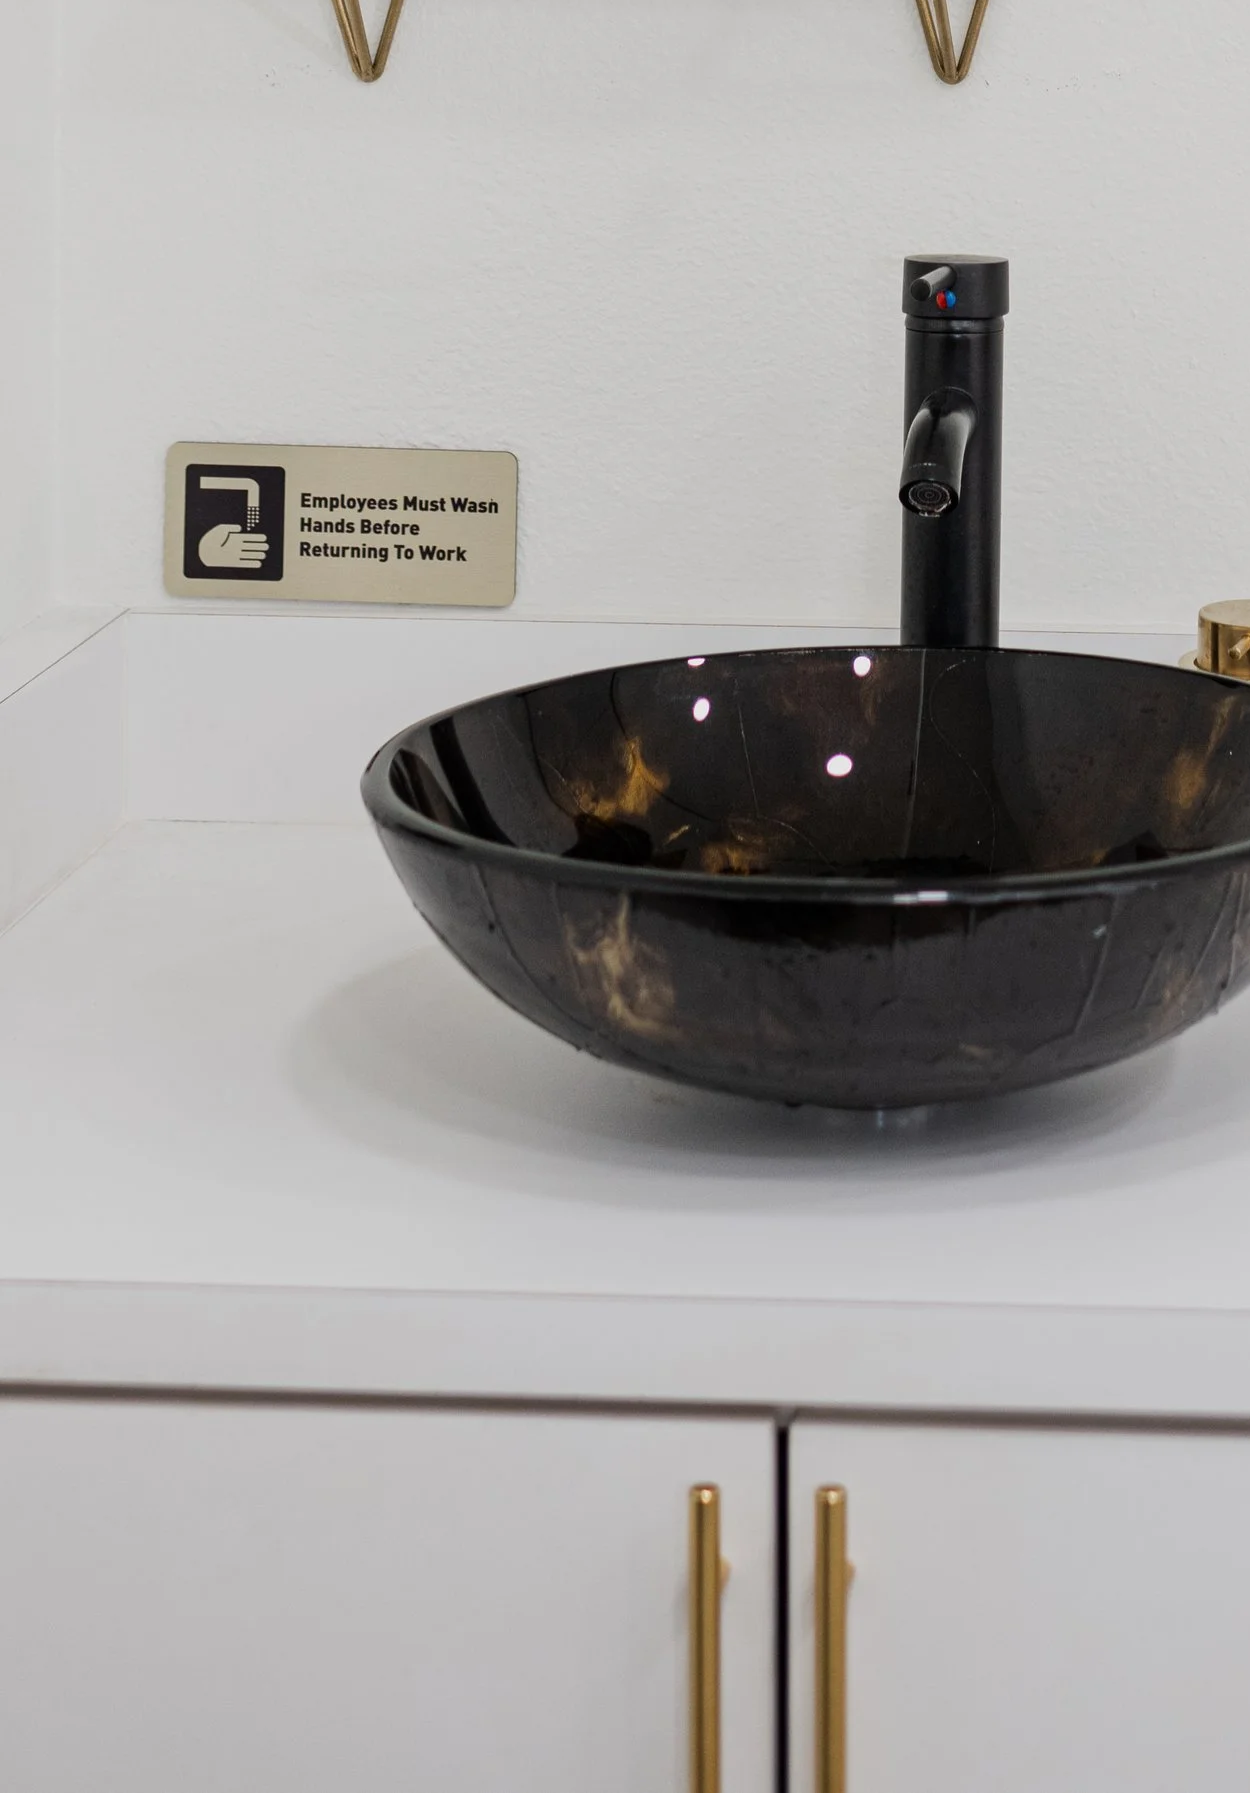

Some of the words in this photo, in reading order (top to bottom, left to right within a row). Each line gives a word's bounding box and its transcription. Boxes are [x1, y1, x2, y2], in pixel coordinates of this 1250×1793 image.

[300, 493, 398, 512] Employees
[403, 496, 446, 512] Must
[300, 517, 355, 533] Hands
[360, 519, 420, 535] Before
[300, 542, 389, 562] Returning
[394, 544, 414, 560] To
[420, 546, 467, 562] Work
